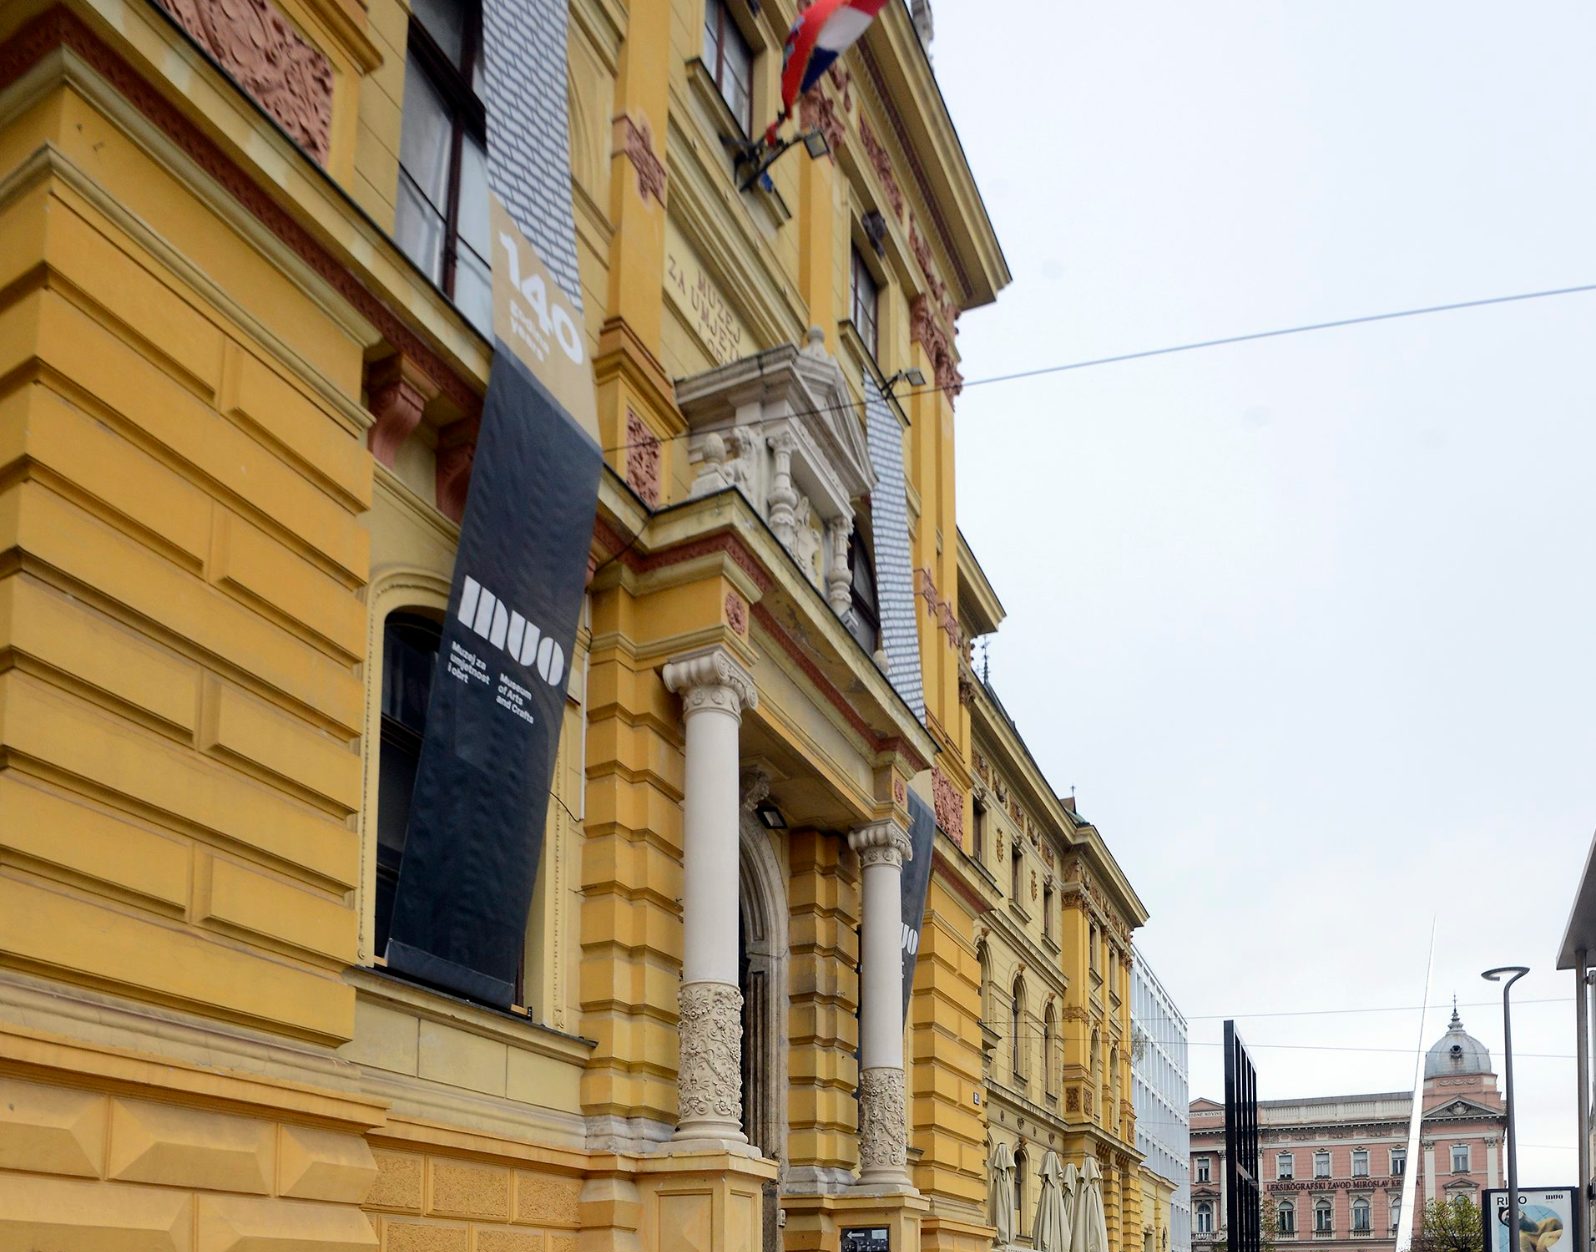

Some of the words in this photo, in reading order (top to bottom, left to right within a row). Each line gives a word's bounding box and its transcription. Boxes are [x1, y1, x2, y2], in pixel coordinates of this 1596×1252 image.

[668, 254, 686, 296] ZA
[499, 232, 583, 364] 140
[698, 269, 740, 345] MUZEJ
[450, 653, 490, 685] umjetnost
[452, 641, 477, 666] Muzej
[476, 658, 487, 671] za
[451, 667, 469, 684] obrt
[500, 673, 532, 700] Museum
[496, 695, 512, 710] and
[511, 704, 534, 724] Crafts
[498, 685, 508, 696] of
[507, 690, 523, 705] Arts
[1267, 1181, 1326, 1192] LEKSIKOGRAFSKI
[1328, 1180, 1351, 1189] ZAVOD
[1353, 1180, 1389, 1189] MIROSLAV
[1391, 1179, 1420, 1188] KRA
[1497, 1196, 1527, 1206] RIO
